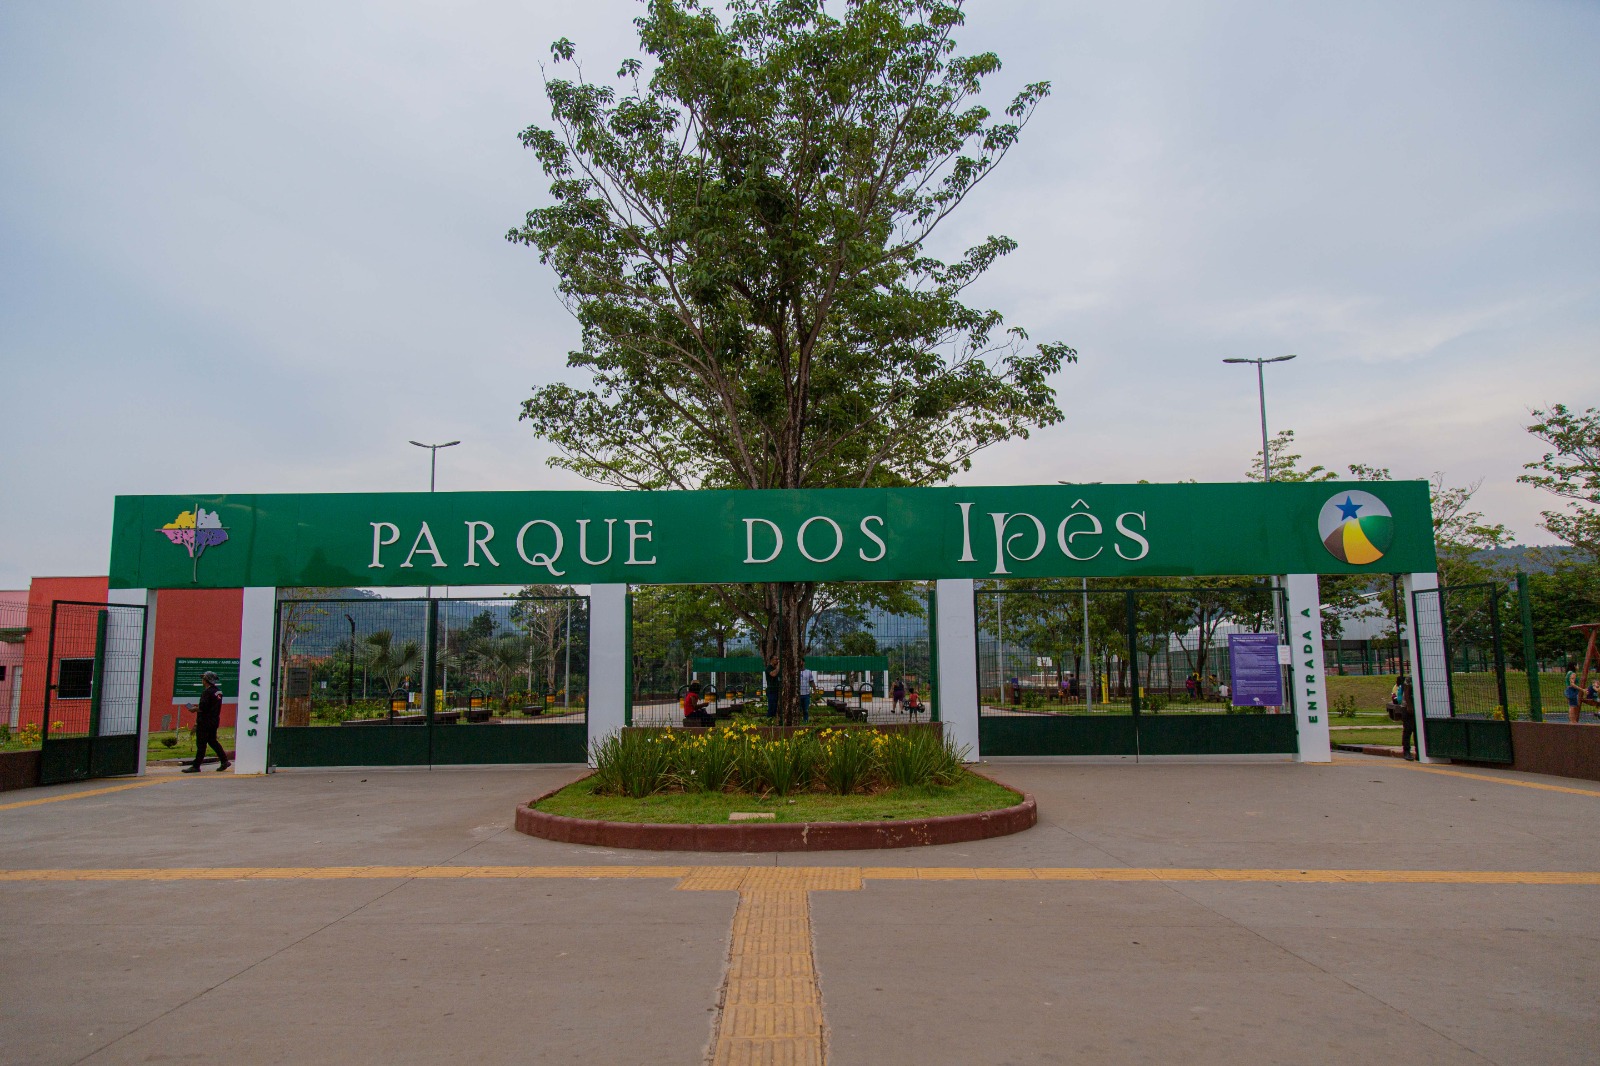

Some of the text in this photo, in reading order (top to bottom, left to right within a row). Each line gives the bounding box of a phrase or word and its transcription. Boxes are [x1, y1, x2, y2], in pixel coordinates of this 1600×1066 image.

[368, 499, 1150, 576] PARQUE DOS Ipês
[247, 657, 262, 737] SAIDA A
[1300, 607, 1319, 724] ENTRADA A
